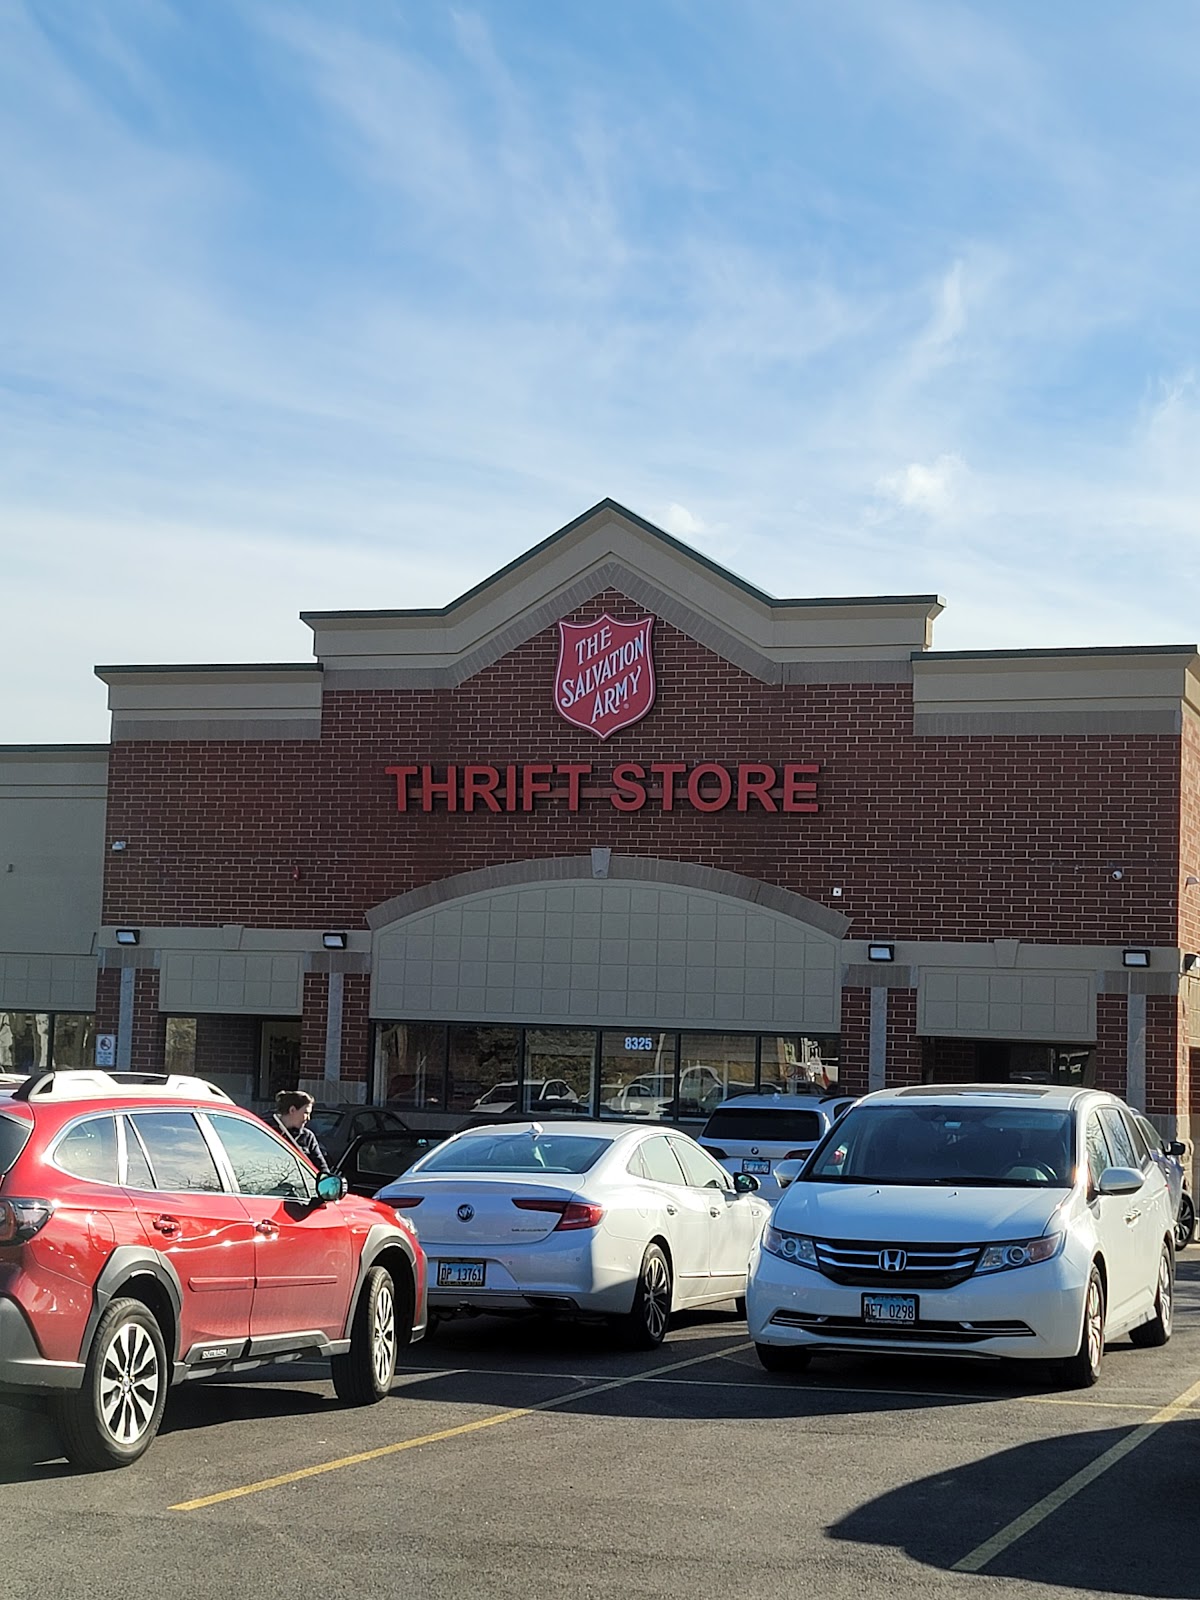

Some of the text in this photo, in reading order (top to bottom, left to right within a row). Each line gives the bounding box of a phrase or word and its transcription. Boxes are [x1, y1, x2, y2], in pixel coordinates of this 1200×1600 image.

[575, 625, 612, 666] THE
[560, 629, 644, 708] SALVATION
[590, 665, 642, 725] ARMY
[385, 763, 820, 814] THRIFT STORE
[624, 1036, 653, 1051] 8325
[457, 1267, 482, 1282] 13761
[889, 1304, 914, 1319] 0298
